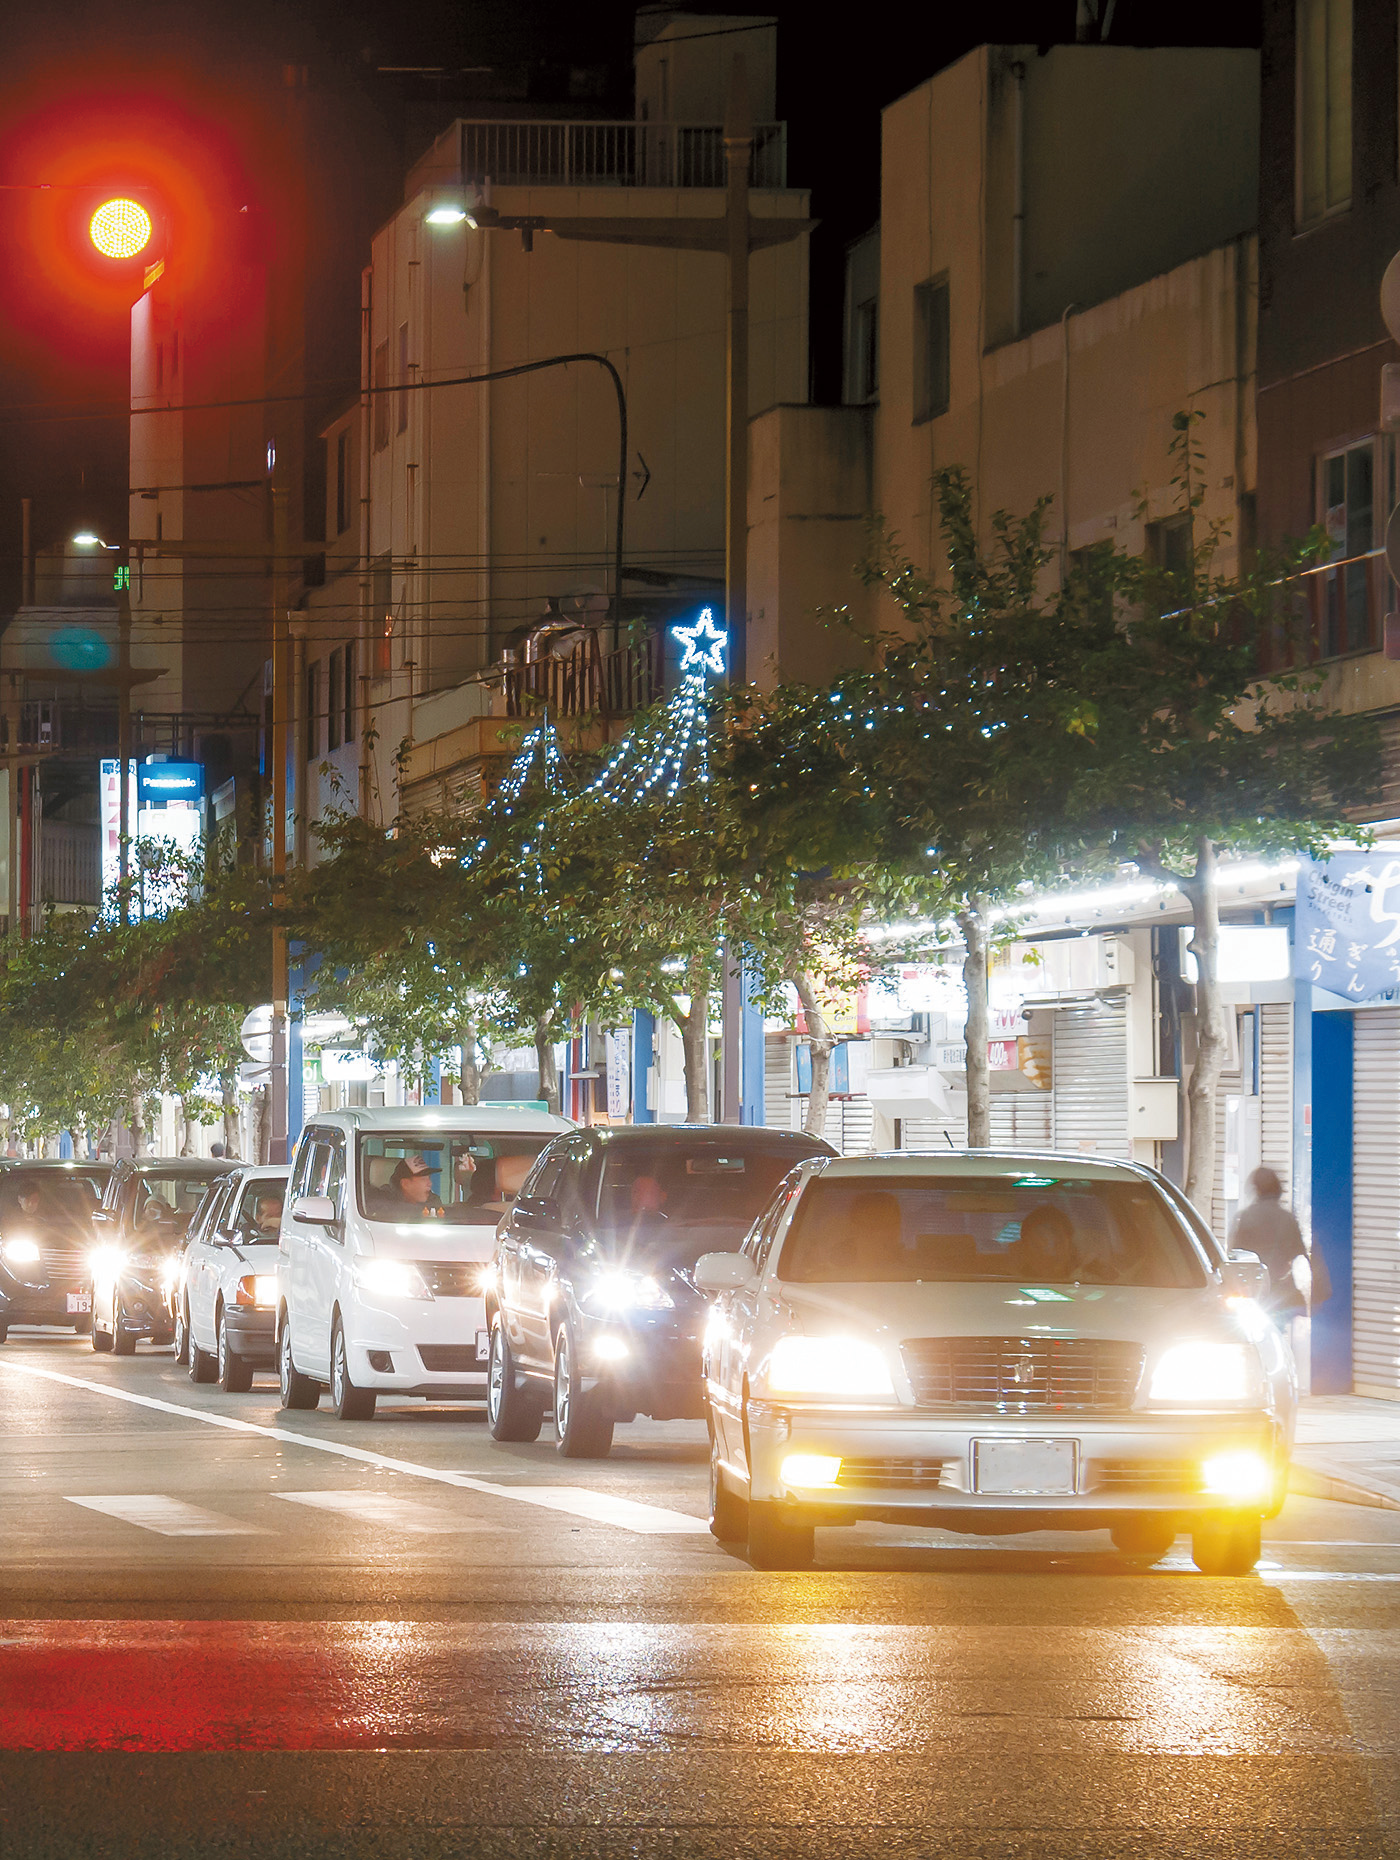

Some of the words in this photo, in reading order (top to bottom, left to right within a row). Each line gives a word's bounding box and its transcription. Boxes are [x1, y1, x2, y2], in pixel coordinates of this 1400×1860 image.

[1307, 886, 1353, 915] Street
[1306, 927, 1338, 981] 通り
[1345, 941, 1369, 993] ぎん
